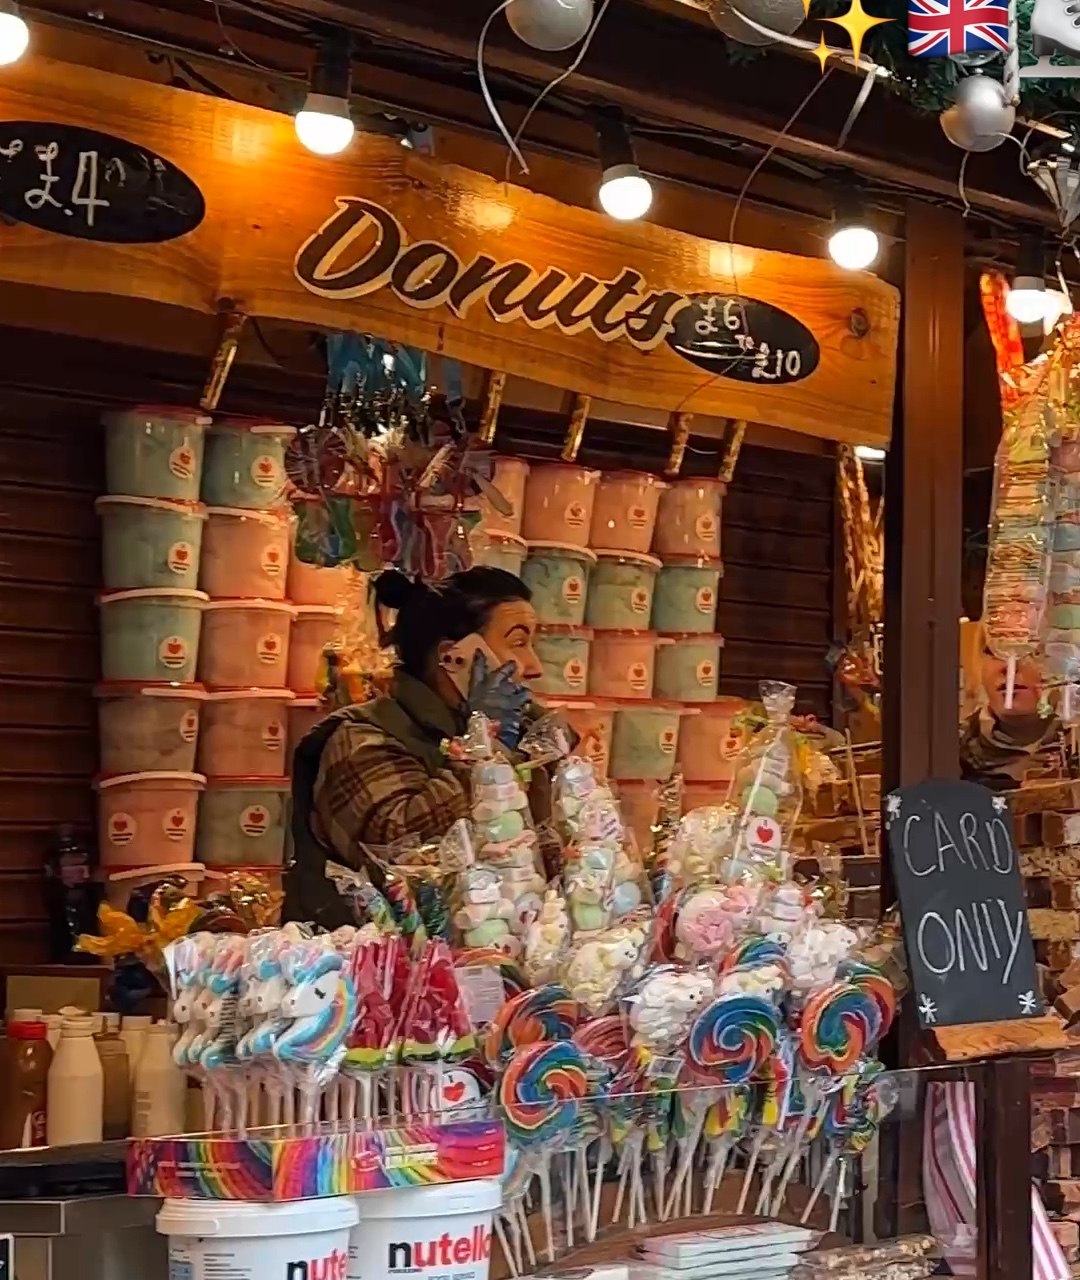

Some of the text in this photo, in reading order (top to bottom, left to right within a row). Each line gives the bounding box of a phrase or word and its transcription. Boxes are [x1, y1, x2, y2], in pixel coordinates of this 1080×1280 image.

[293, 196, 680, 352] Donuts
[694, 295, 741, 336] £6
[751, 342, 802, 379] £10
[903, 811, 1014, 876] CARD
